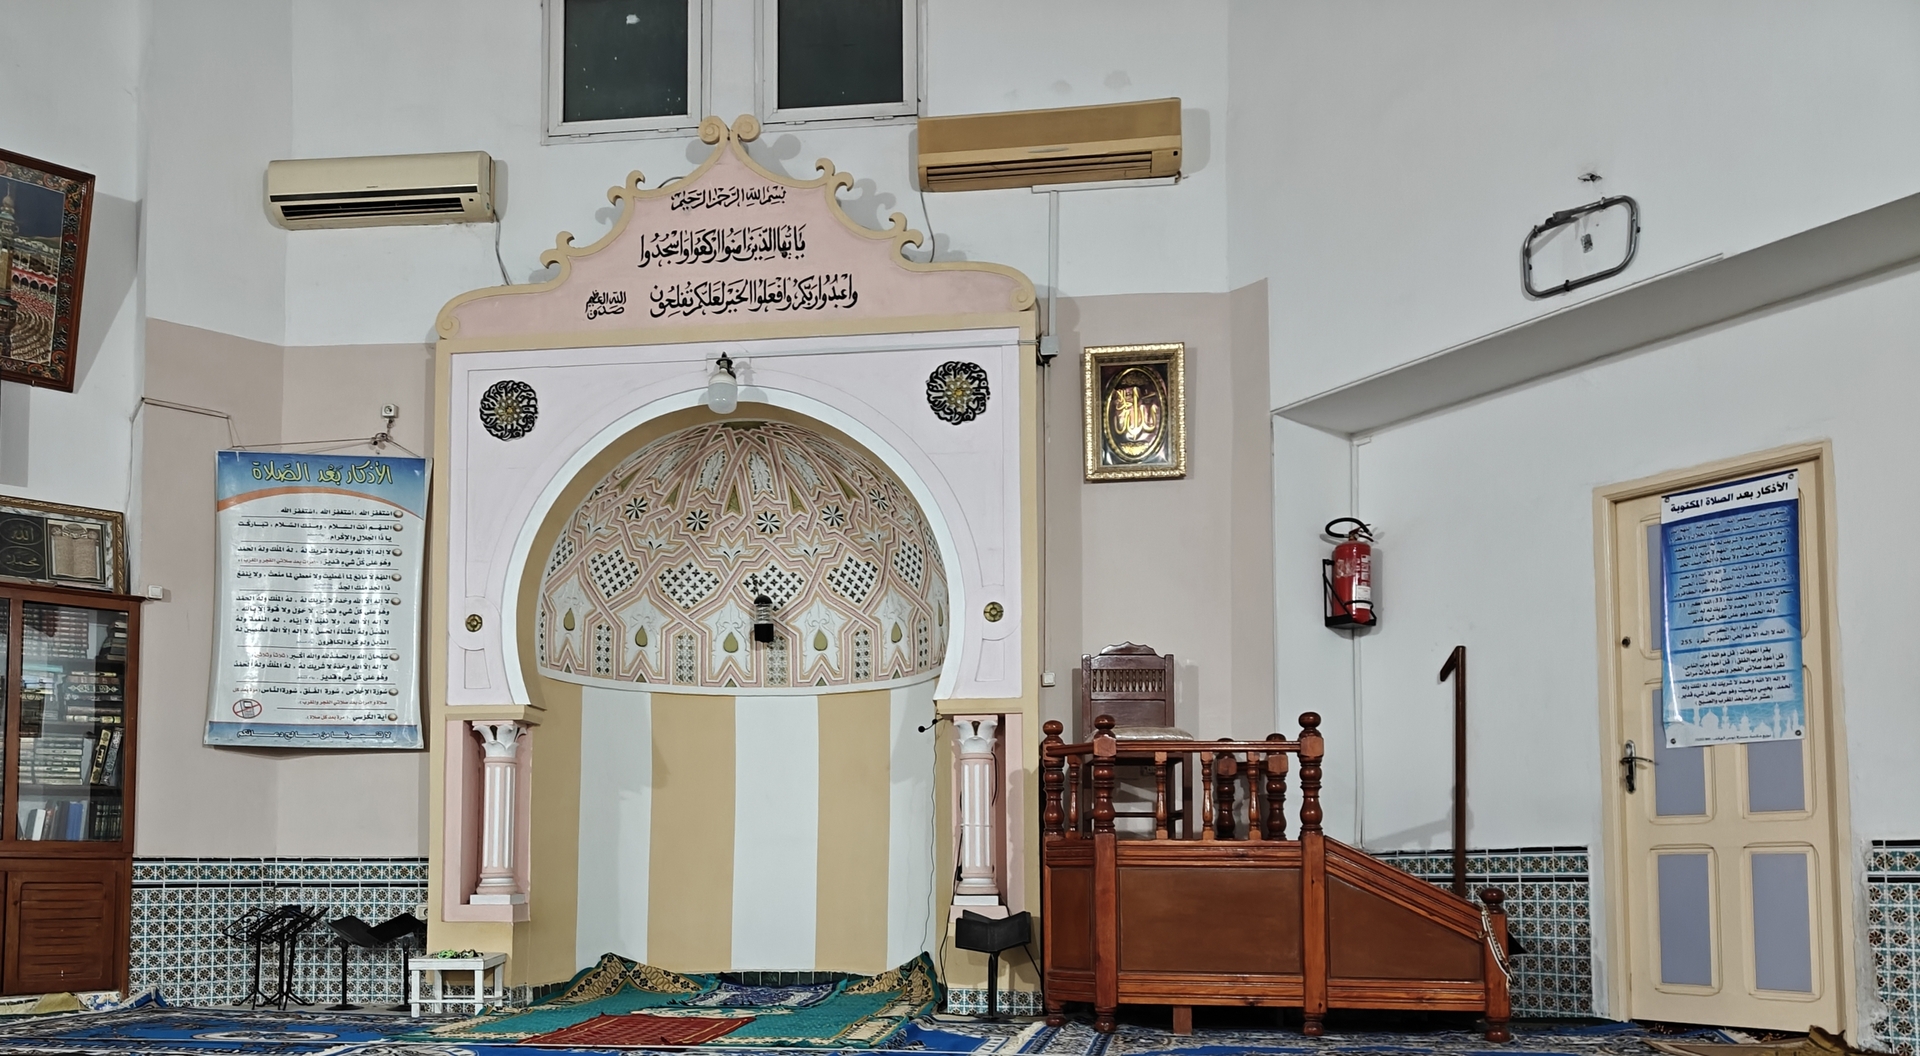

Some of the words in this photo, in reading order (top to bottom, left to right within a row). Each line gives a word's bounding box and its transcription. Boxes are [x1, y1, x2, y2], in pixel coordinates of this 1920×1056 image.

[1705, 492, 1734, 507] الصلاة
[1736, 491, 1754, 501] بعد
[1670, 498, 1703, 514] المكتوبة
